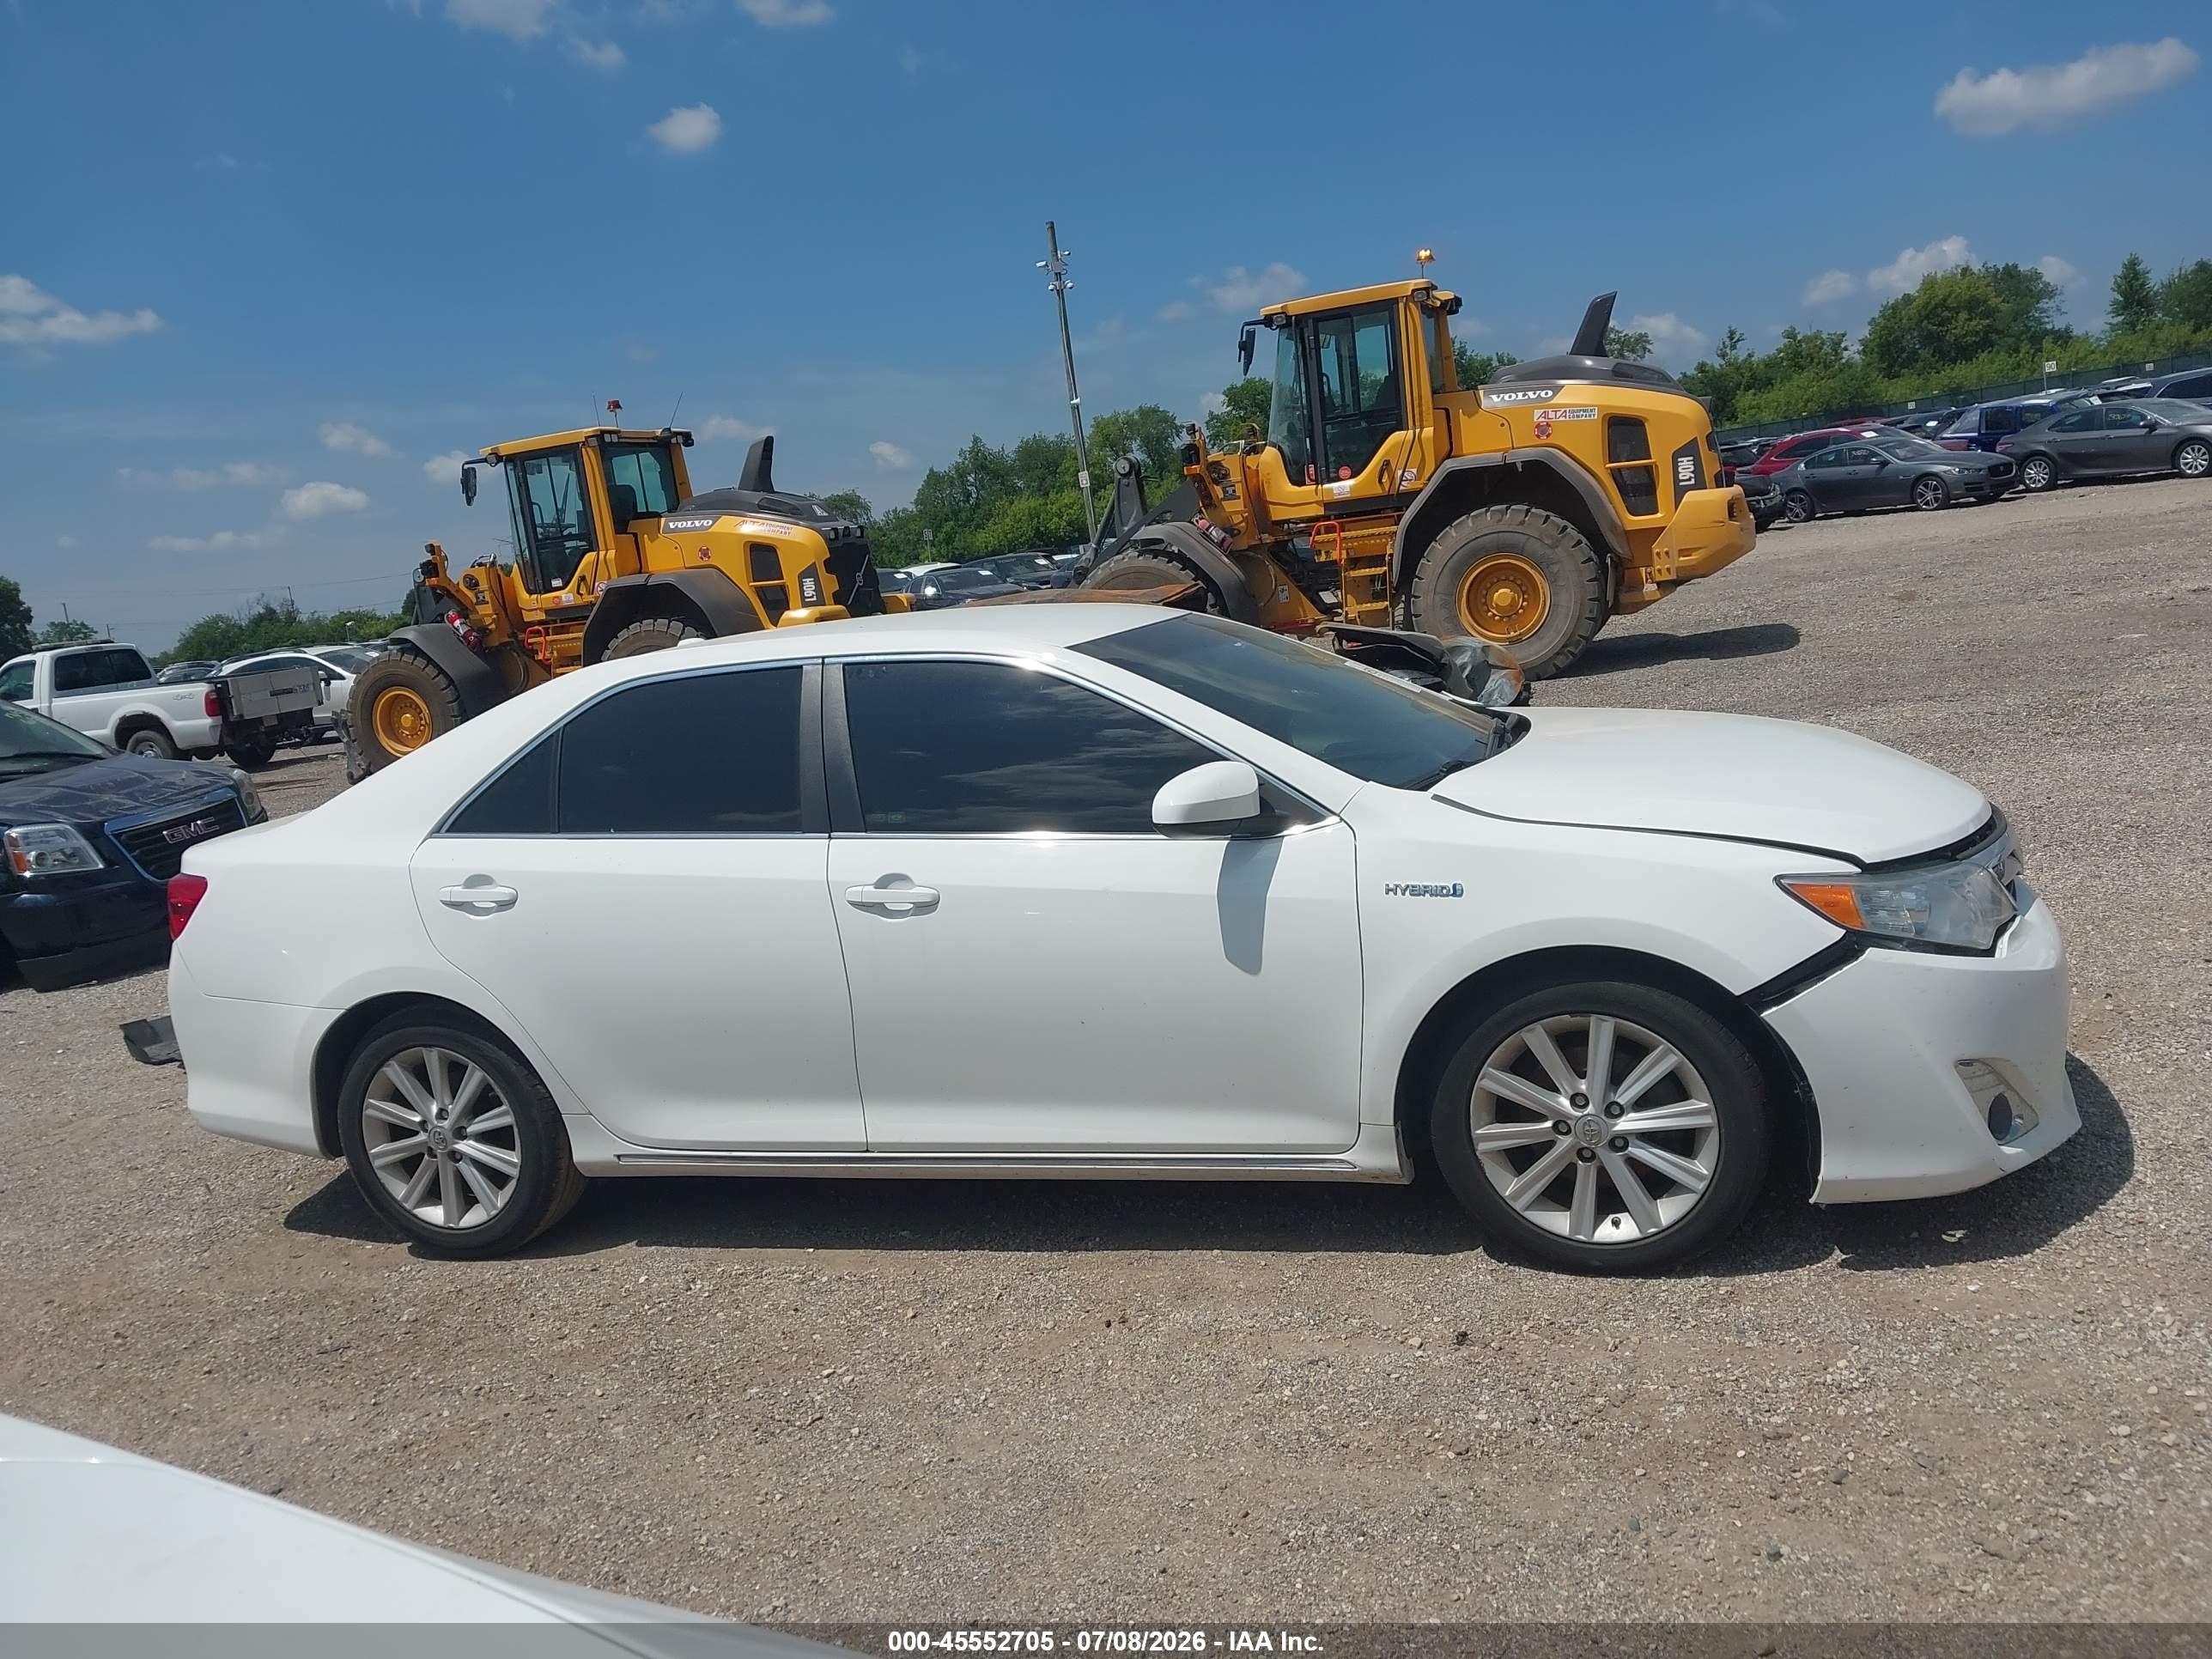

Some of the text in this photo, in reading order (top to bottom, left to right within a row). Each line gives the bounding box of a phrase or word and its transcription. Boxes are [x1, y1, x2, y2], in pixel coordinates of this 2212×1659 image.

[2045, 362, 2056, 371] 90
[1489, 390, 1553, 403] VOLVO
[1535, 410, 1567, 421] ALTA
[1677, 456, 1695, 486] L90H
[668, 520, 713, 529] VOLVO
[802, 578, 817, 602] L90H
[162, 817, 220, 844] GMC
[1384, 883, 1451, 897] HYBRID
